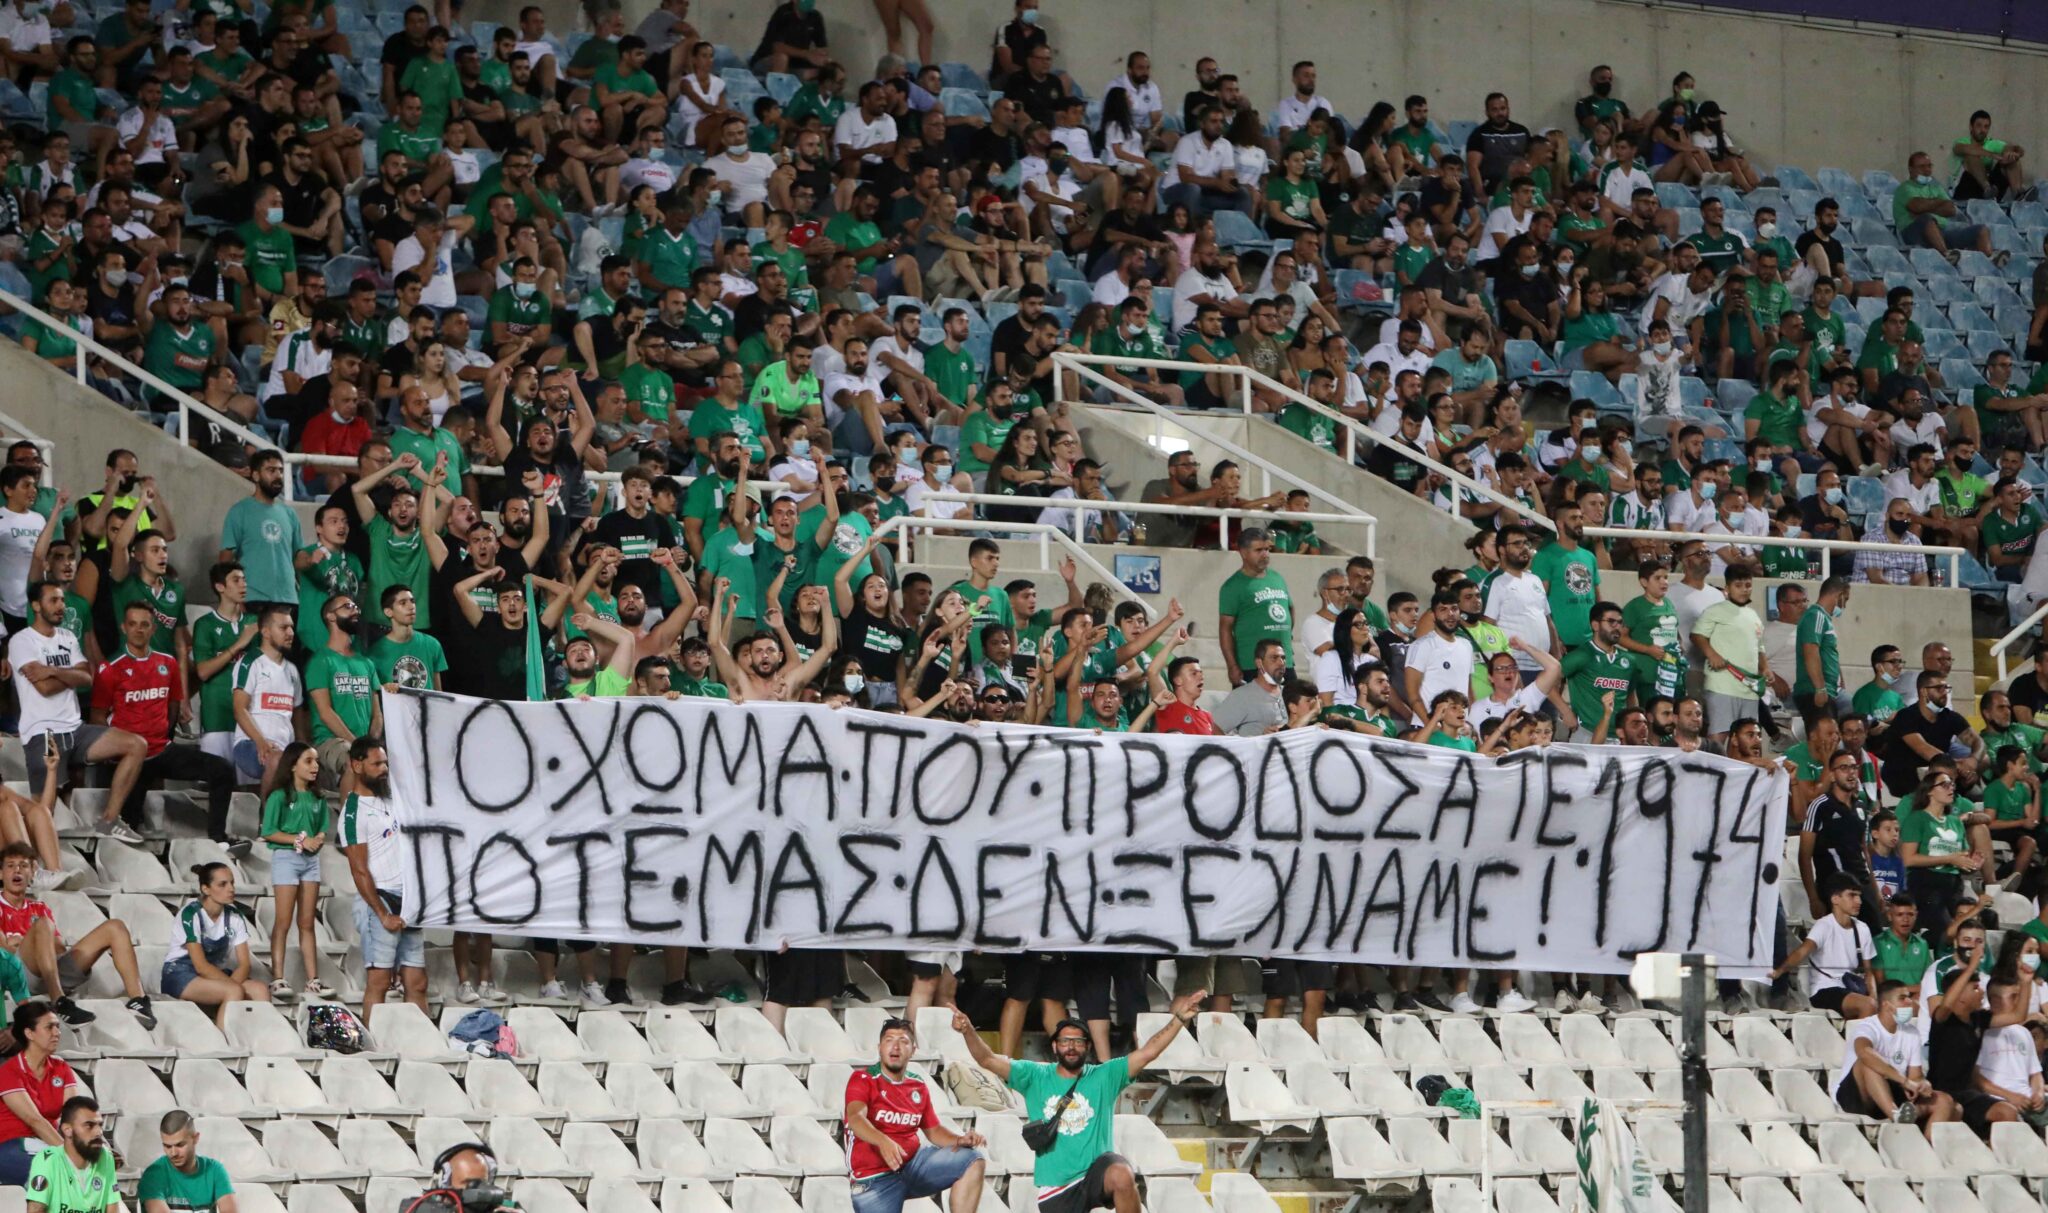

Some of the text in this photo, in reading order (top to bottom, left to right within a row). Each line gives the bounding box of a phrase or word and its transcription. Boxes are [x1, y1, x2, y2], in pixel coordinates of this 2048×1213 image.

[124, 686, 170, 704] FONBET
[399, 687, 535, 814] ΤΟ
[846, 720, 1036, 827] ΠΟΥ
[401, 824, 690, 933] ΠΟΤΕ
[700, 829, 902, 944] ΜΑΣ
[906, 834, 1097, 947] ΔΕΝ
[875, 1110, 922, 1126] FONBET
